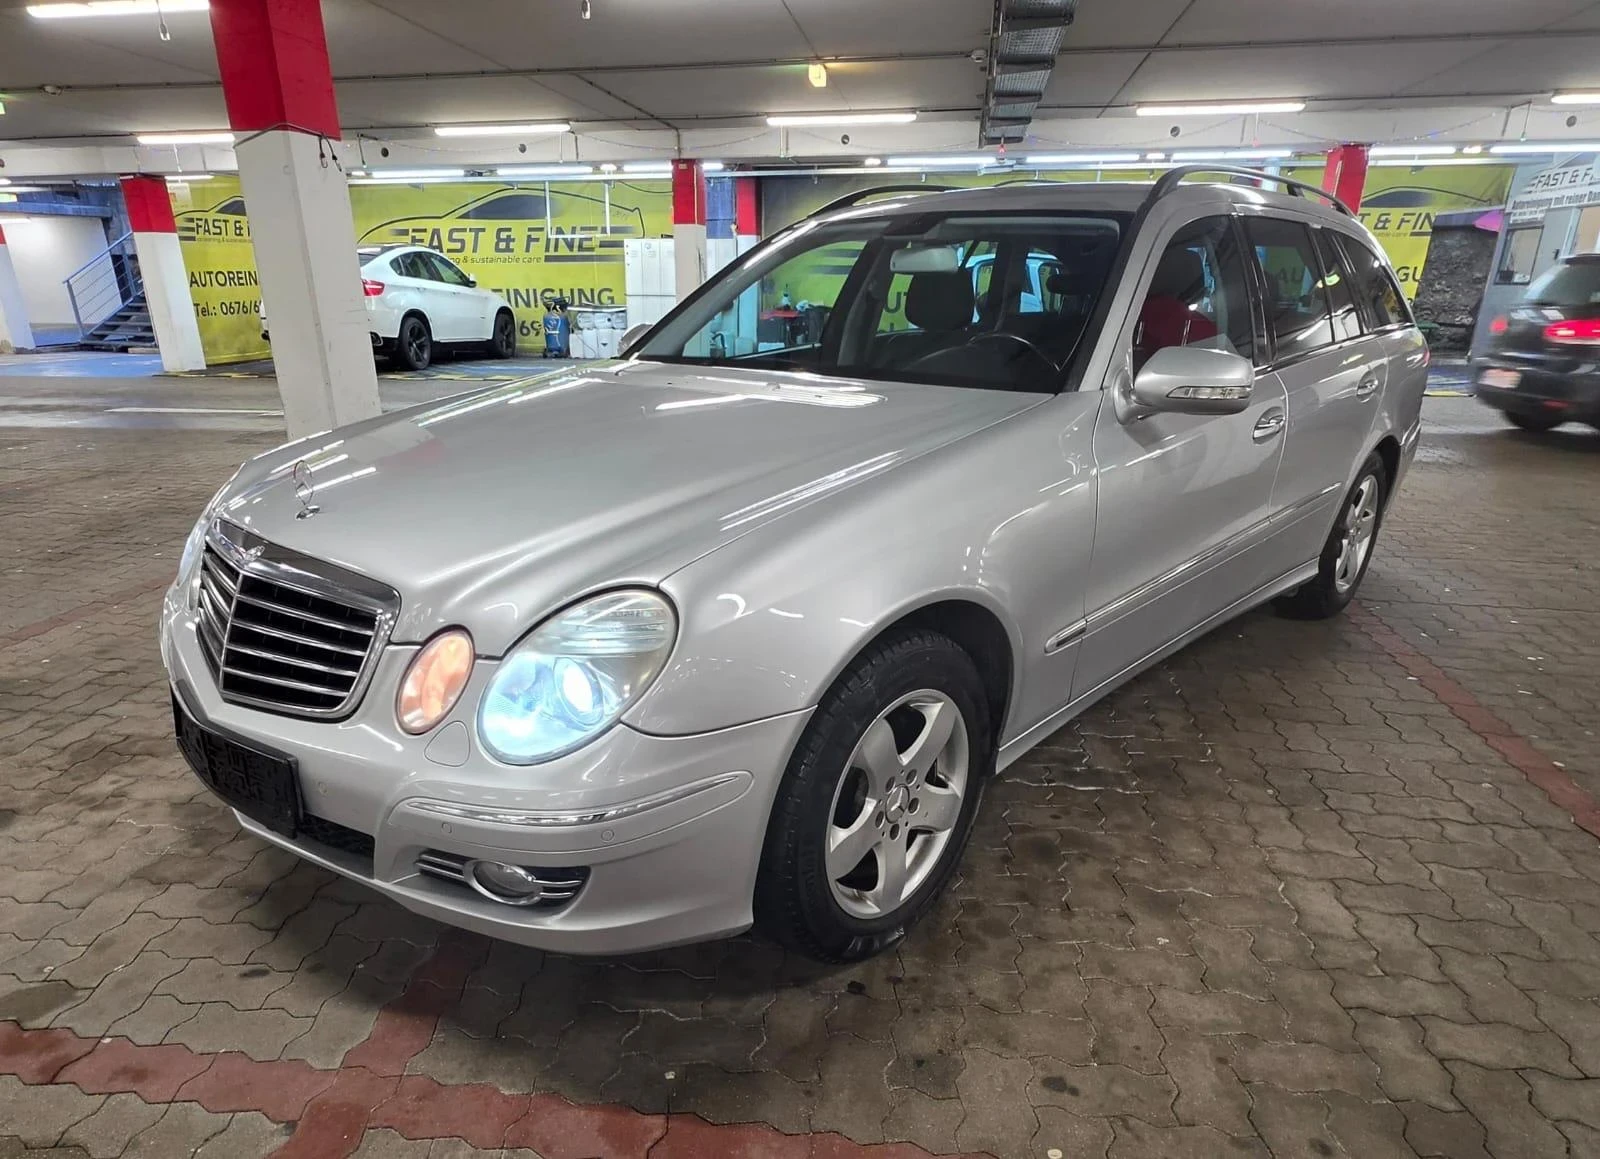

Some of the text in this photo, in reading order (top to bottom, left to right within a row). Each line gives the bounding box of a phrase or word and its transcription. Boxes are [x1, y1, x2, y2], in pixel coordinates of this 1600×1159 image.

[1535, 172, 1568, 189] FAST
[195, 218, 230, 237] FAST
[234, 219, 244, 237] &
[1373, 212, 1391, 230] &
[410, 226, 598, 253] FAST & FINE
[470, 255, 520, 264] sustainable
[189, 270, 258, 288] AUTOREIN
[193, 299, 262, 318] Tel.: 0676/6
